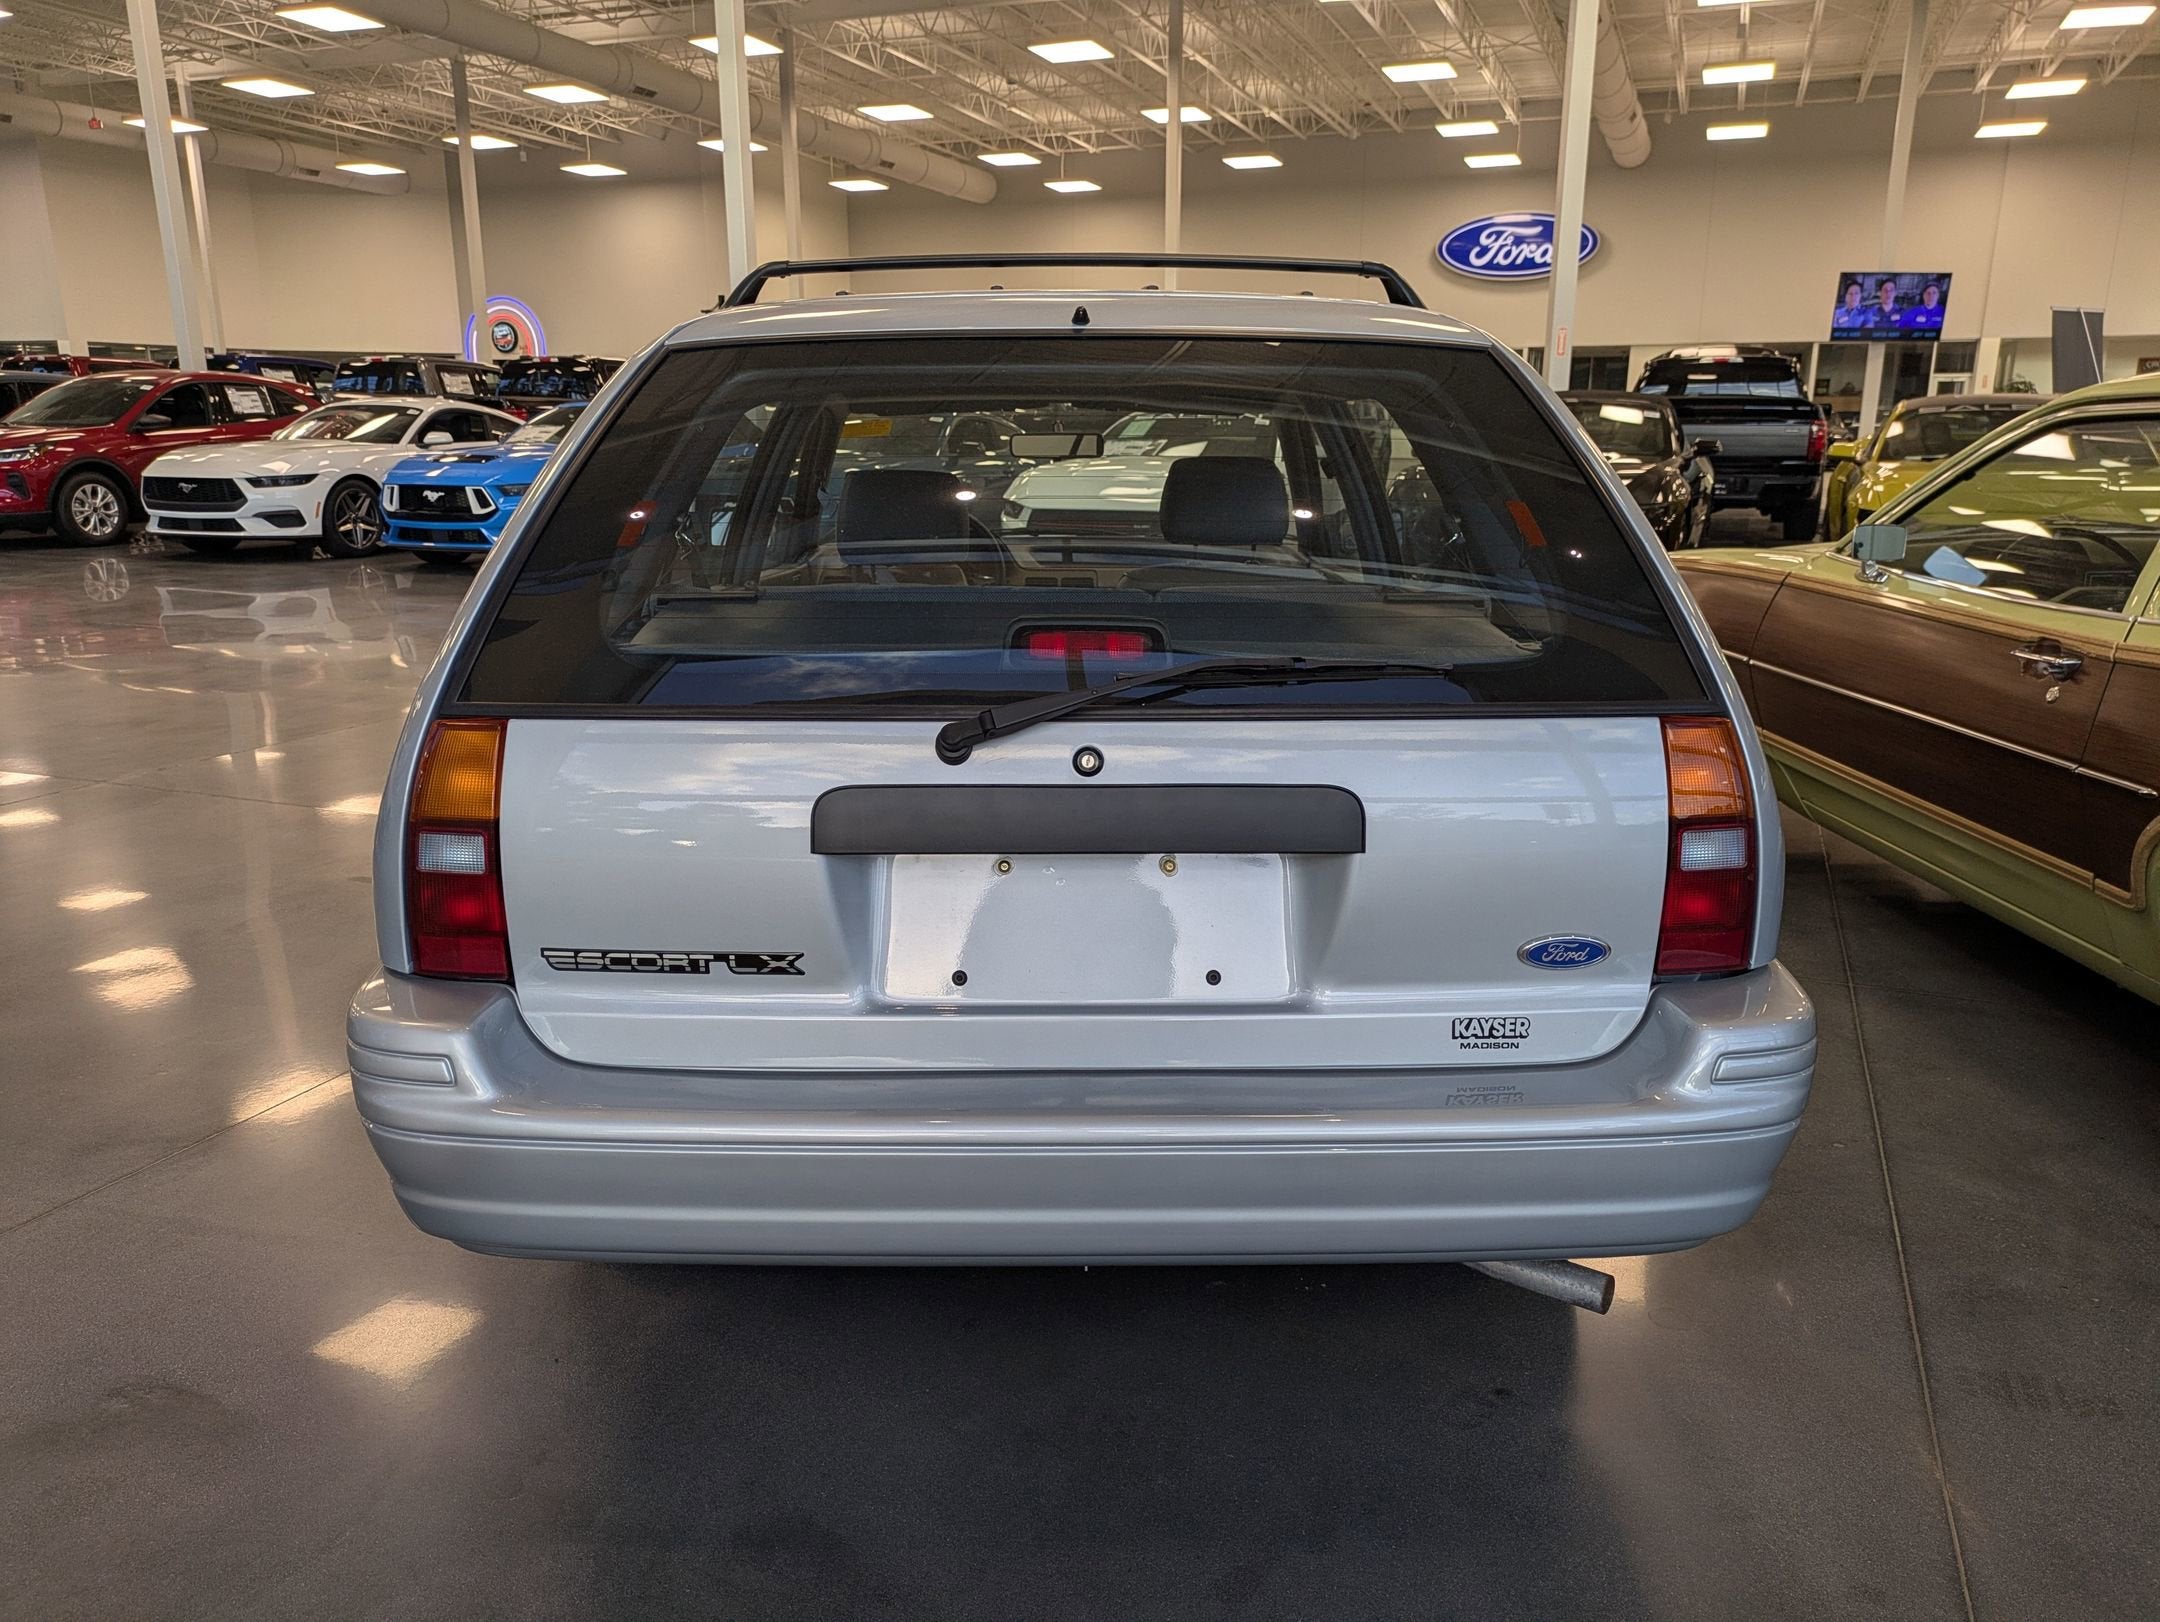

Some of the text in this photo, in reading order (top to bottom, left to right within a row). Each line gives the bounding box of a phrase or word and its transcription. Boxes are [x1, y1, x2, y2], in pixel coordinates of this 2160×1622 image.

[541, 948, 805, 975] ESCORT LX
[1541, 943, 1590, 962] Ford
[1452, 1017, 1531, 1040] KAYSER
[1460, 1041, 1520, 1050] MADISON
